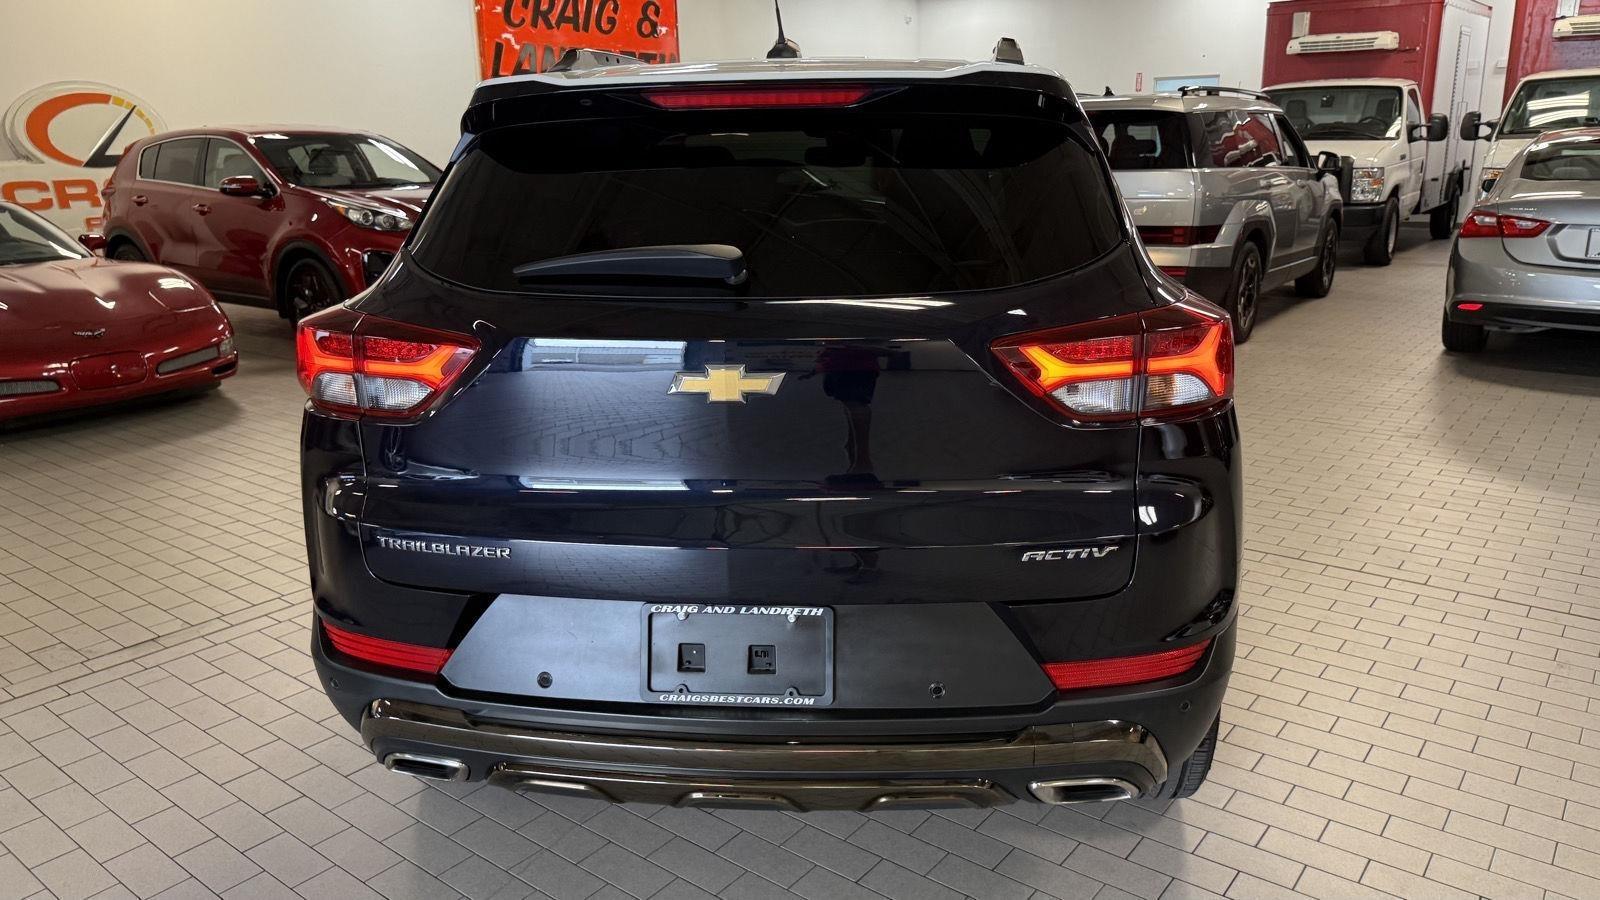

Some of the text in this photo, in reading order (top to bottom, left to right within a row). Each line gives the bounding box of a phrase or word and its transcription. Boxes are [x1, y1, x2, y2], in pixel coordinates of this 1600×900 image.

[503, 0, 661, 38] CRAIG &
[377, 536, 511, 559] TRAILBLAZER
[1022, 546, 1119, 562] ACTIV
[650, 604, 824, 616] CRAIG AND LANDRETH
[659, 694, 815, 705] CRAIGSBESTCARS.COM
